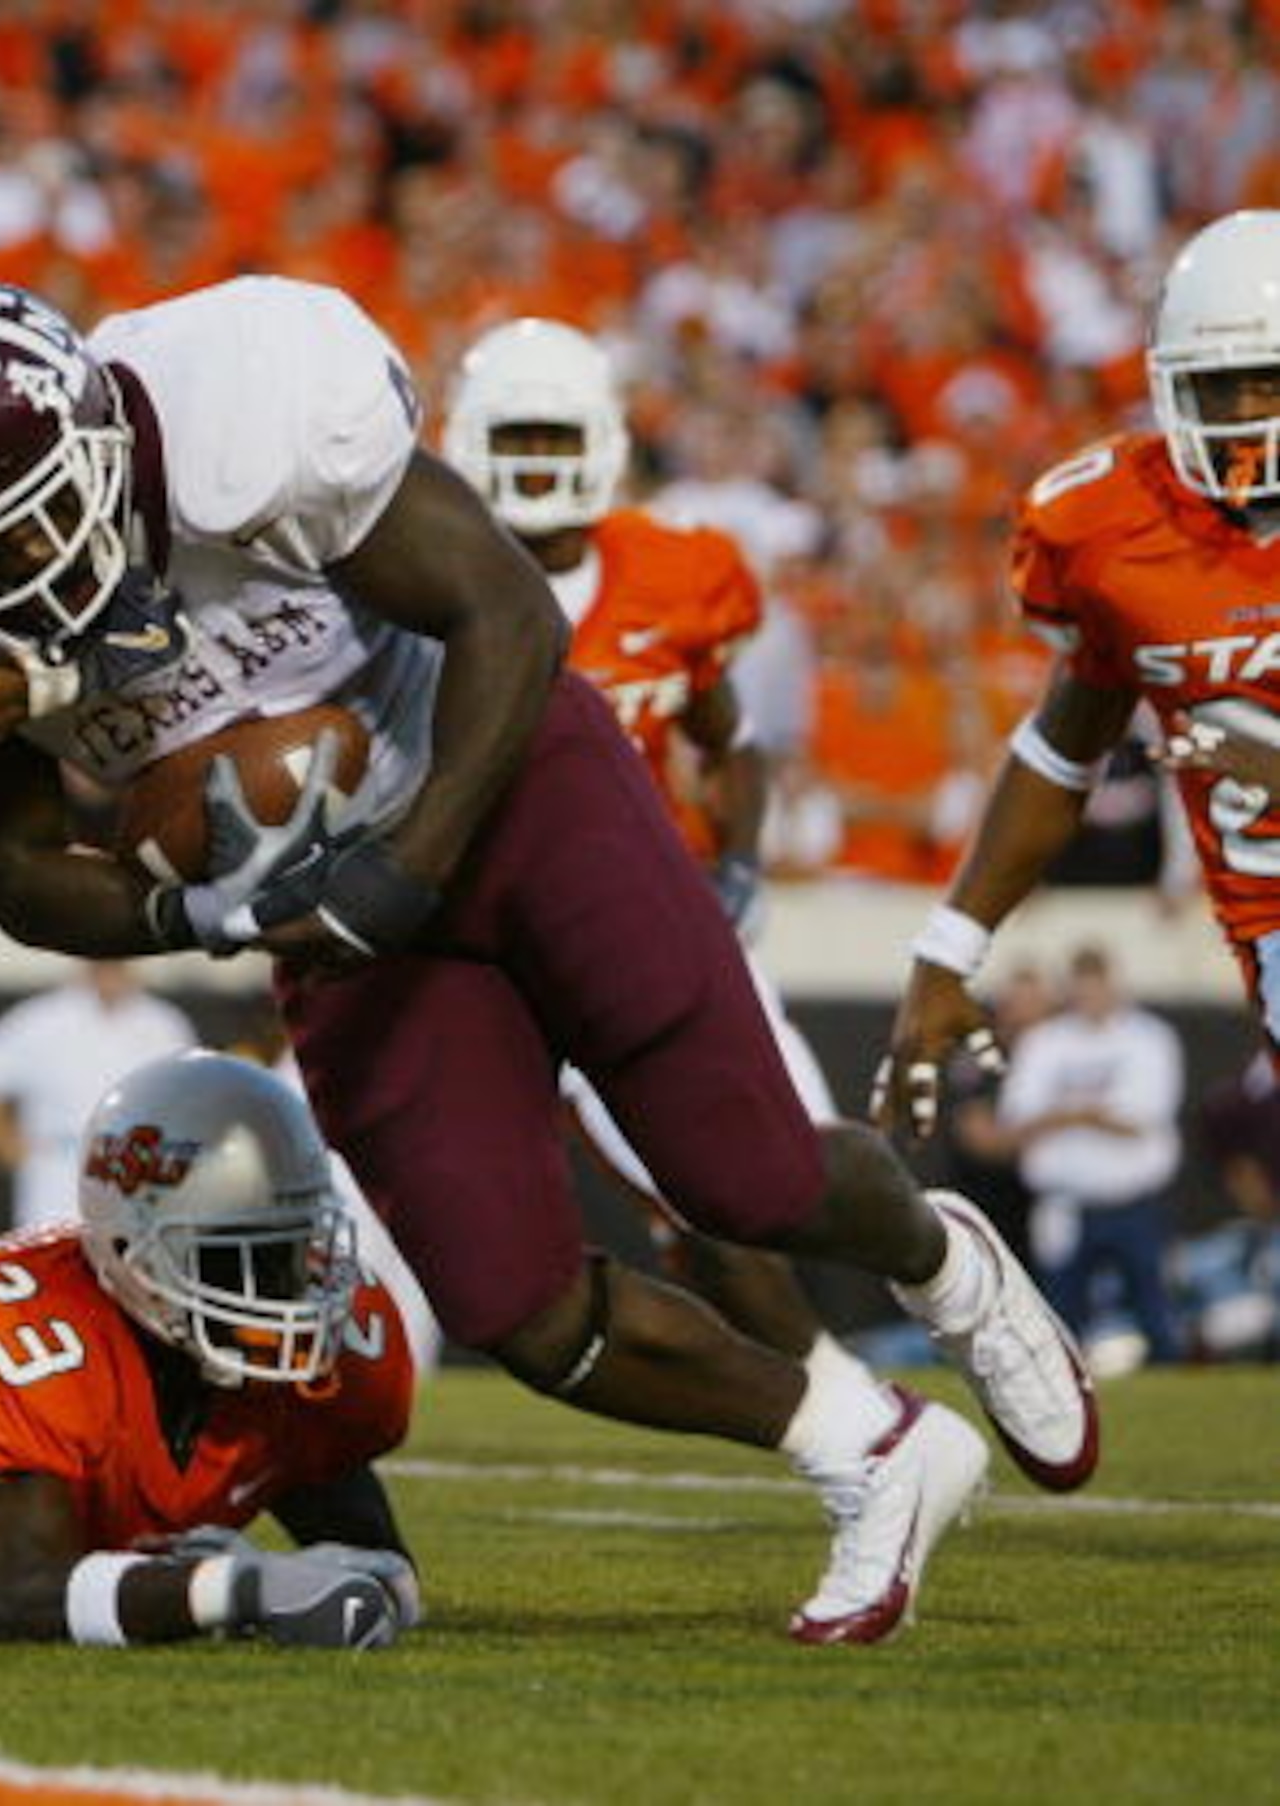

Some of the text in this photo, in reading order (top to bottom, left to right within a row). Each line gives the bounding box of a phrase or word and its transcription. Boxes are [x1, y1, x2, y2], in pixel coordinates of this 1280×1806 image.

[73, 599, 327, 770] TEXAS A&M
[1132, 632, 1280, 687] STA
